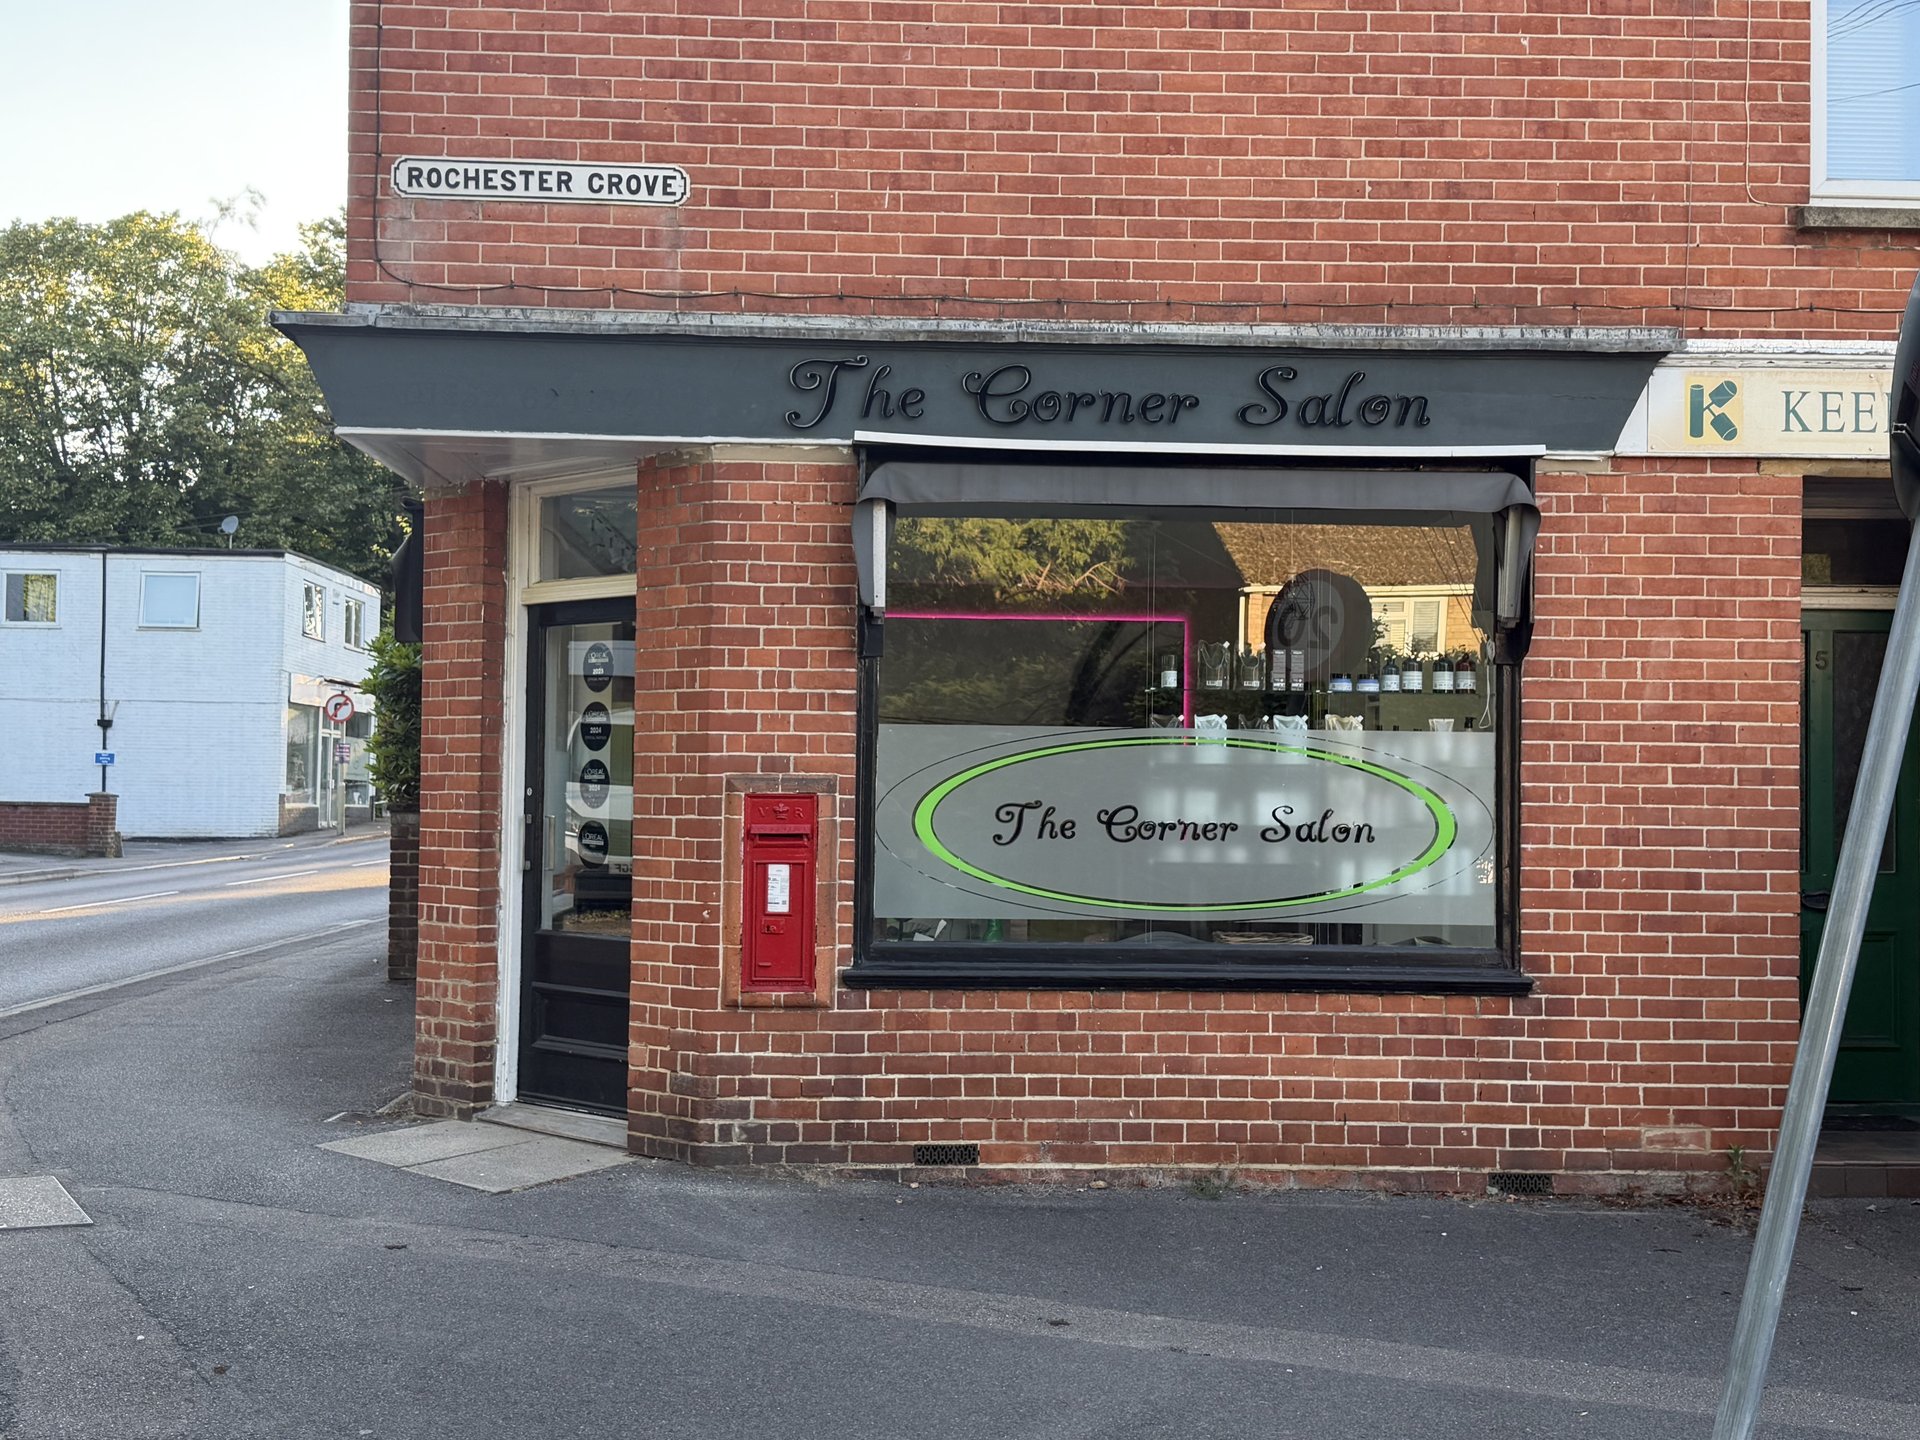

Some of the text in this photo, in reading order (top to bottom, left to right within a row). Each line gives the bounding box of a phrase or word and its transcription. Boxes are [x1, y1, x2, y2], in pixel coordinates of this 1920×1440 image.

[407, 166, 573, 193] ROCHESTER
[784, 354, 1431, 428] The Corner Salon
[1781, 390, 1891, 433] KEE
[1815, 650, 1829, 671] 5
[758, 806, 804, 818] V R
[992, 799, 1376, 846] The Corner Salon
